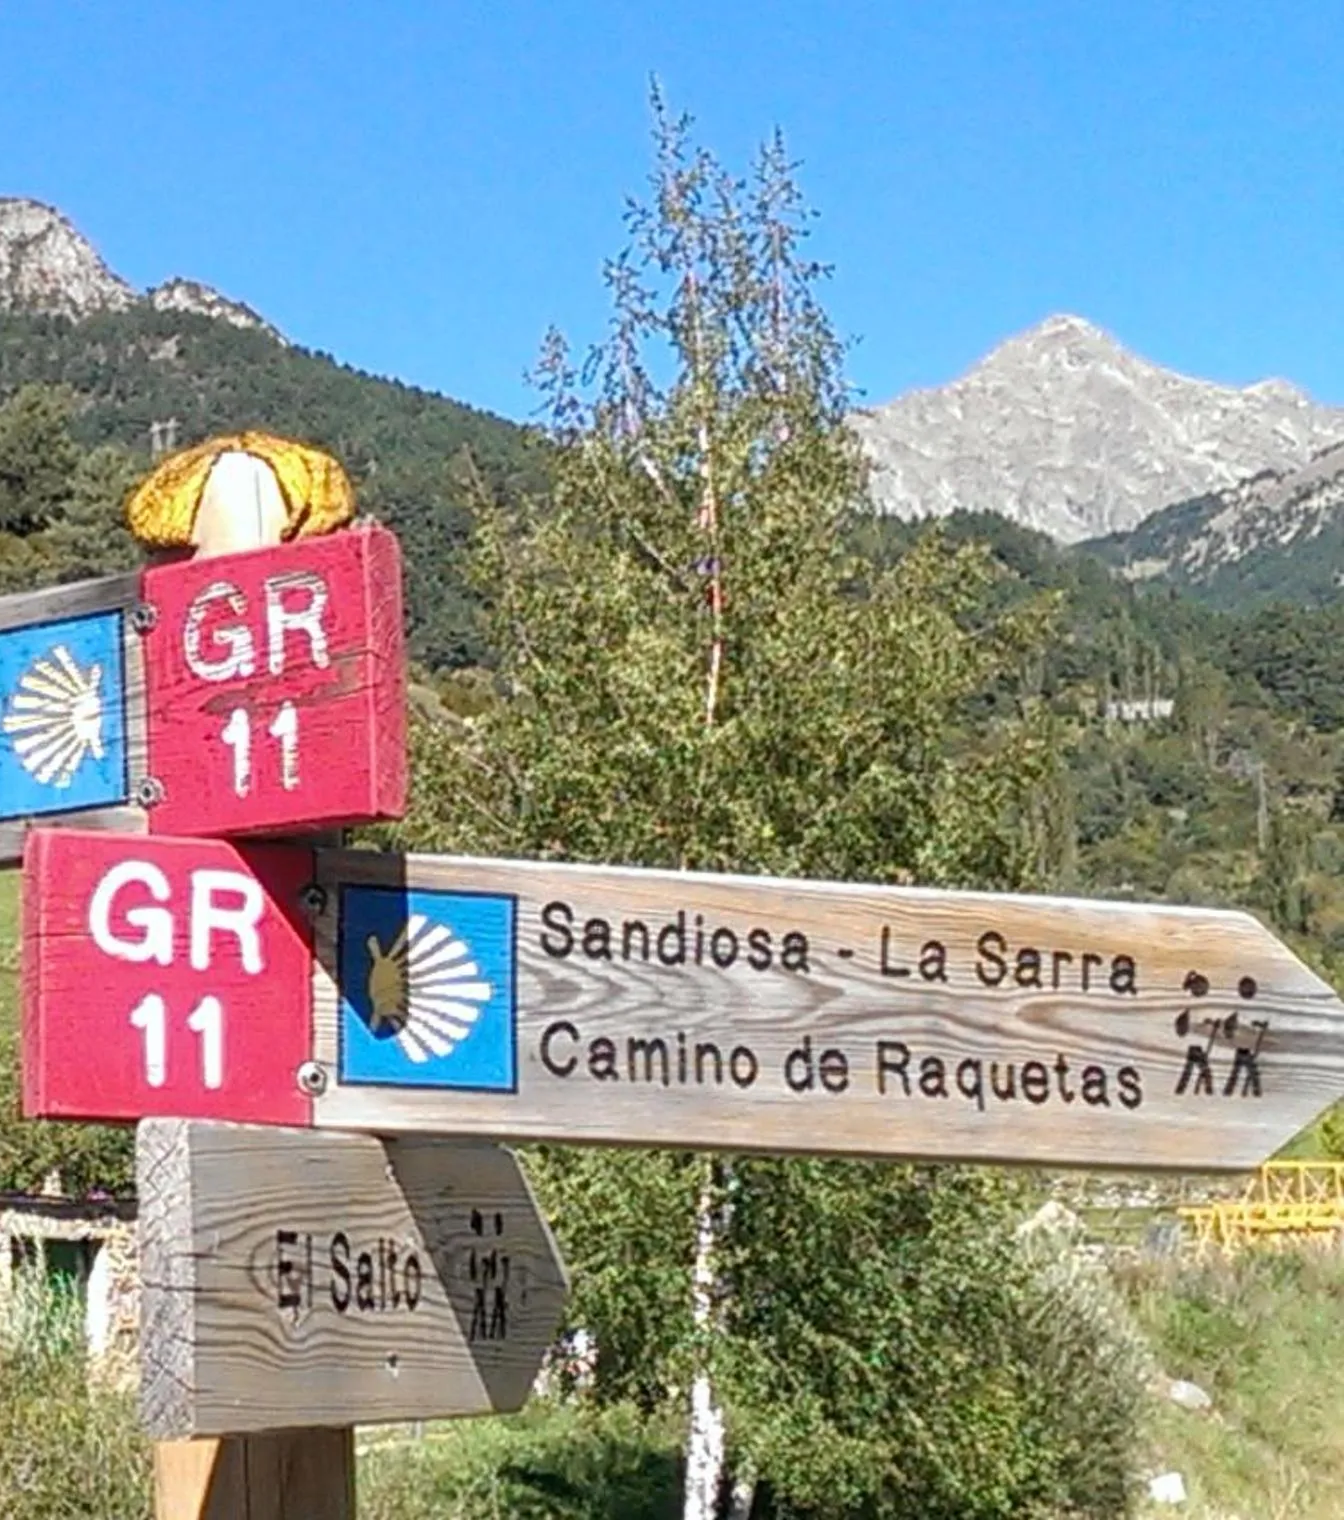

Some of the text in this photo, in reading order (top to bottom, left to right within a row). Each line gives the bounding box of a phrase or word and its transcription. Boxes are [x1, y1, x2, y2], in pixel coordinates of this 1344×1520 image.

[183, 571, 330, 683] GR
[221, 700, 301, 799] 11
[88, 859, 266, 975] GR
[539, 900, 811, 972] Sandiosa
[881, 924, 950, 981] La
[975, 930, 1140, 996] Sarra
[129, 992, 230, 1090] 11
[539, 1020, 1145, 1111] Camino de Raquetas
[276, 1229, 422, 1314] El Salto
